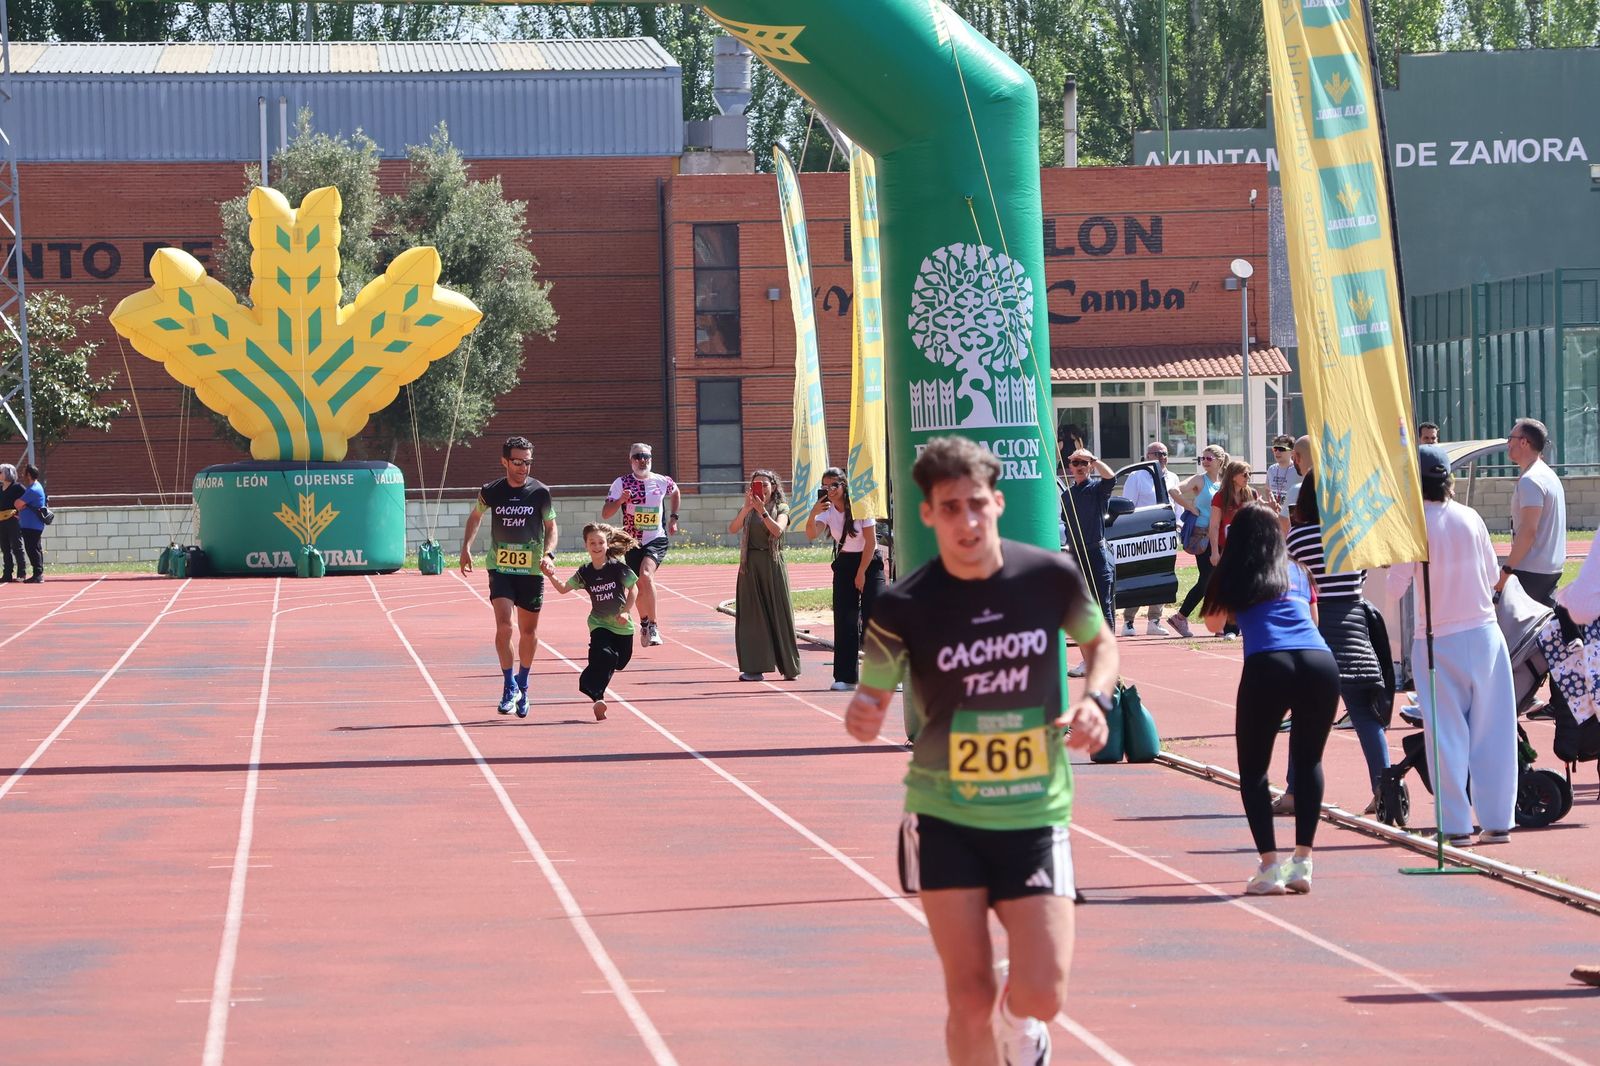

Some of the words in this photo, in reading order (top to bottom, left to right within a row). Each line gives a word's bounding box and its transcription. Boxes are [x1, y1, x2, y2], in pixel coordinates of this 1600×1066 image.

[1395, 142, 1437, 167] DE
[1449, 137, 1588, 165] ZAMORA
[236, 473, 268, 488] LEÓN
[294, 474, 354, 486] OURENSE
[495, 506, 534, 515] CACHOPO
[636, 513, 656, 524] 354
[502, 517, 526, 527] TEAM
[1116, 536, 1167, 559] AUTOMÓVILES
[245, 551, 295, 569] CAJA
[500, 551, 527, 565] 203
[596, 592, 614, 602] TEAM
[937, 628, 1048, 672] CACHOPO
[963, 666, 1029, 696] TEAM
[958, 736, 1033, 773] 266
